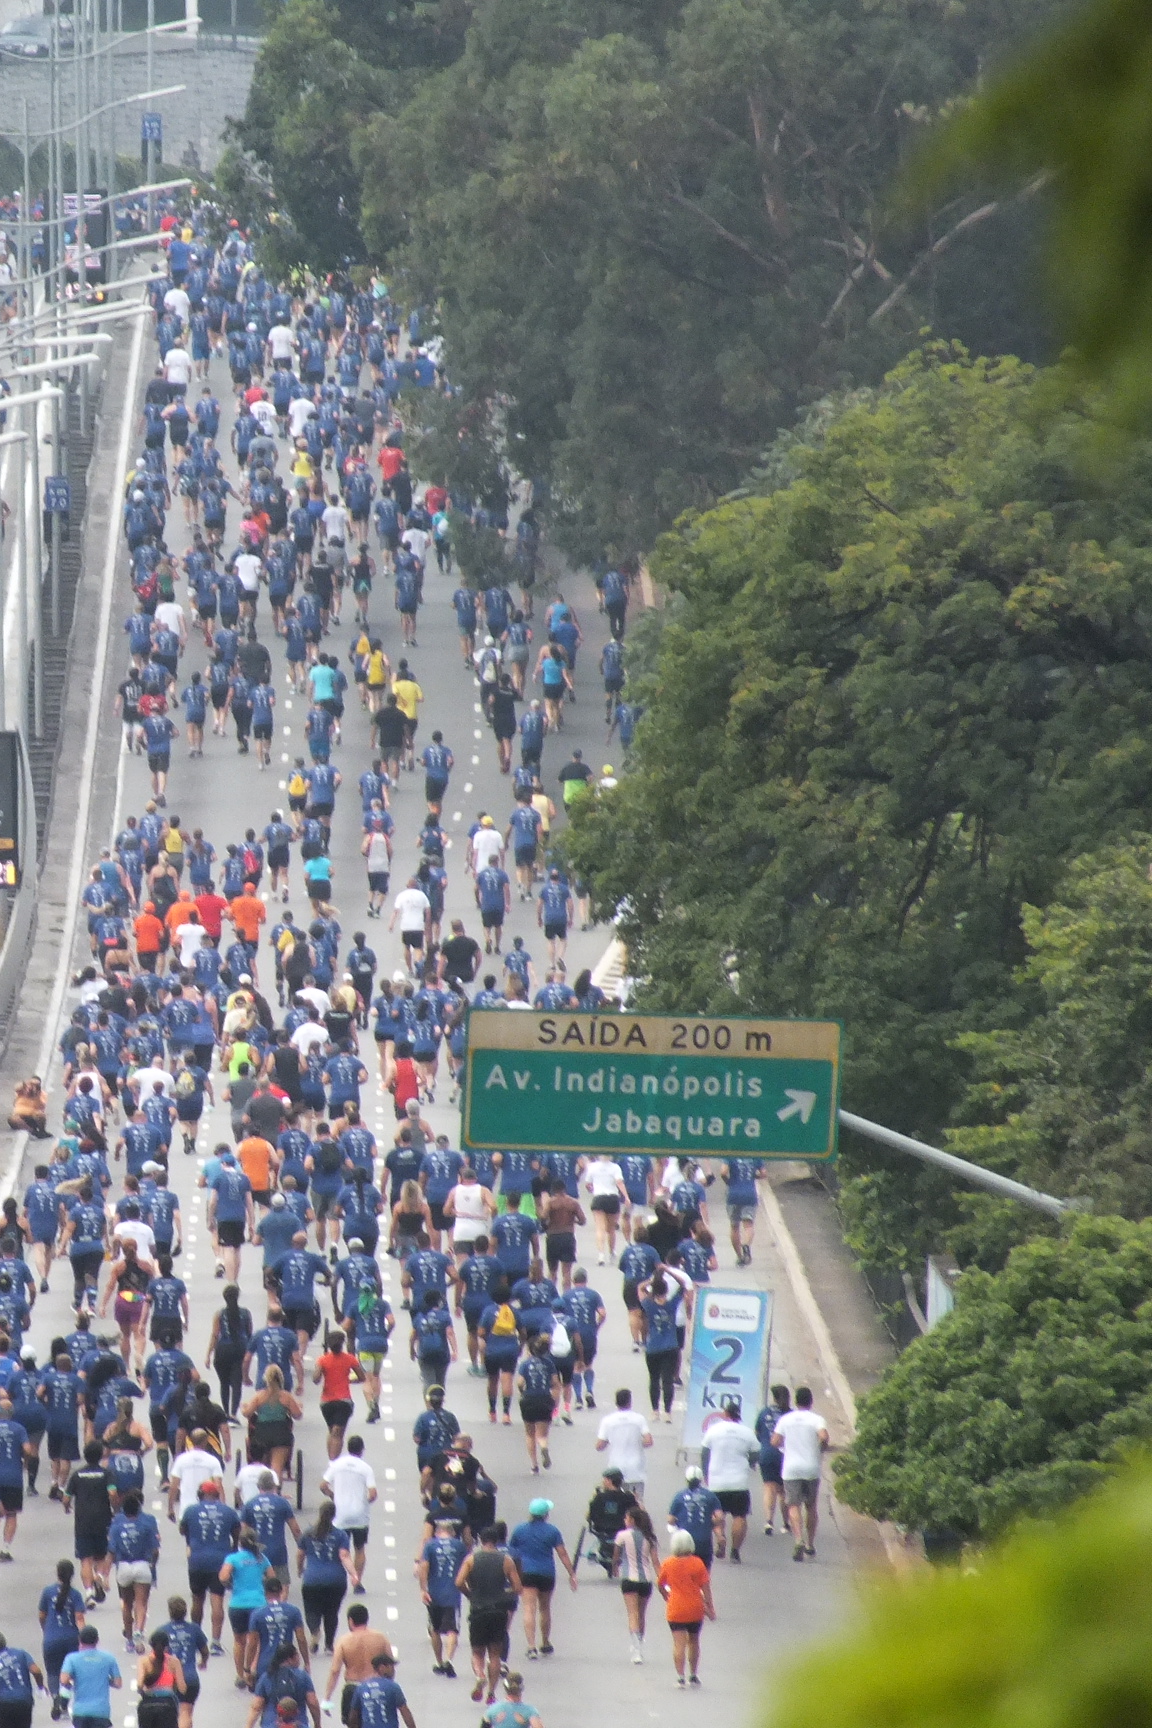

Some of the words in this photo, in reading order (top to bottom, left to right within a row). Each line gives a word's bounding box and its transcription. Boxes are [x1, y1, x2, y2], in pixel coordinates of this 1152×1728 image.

[538, 1016, 647, 1048] SAÍDA
[670, 1023, 732, 1050] 200
[745, 1029, 772, 1052] m
[485, 1064, 540, 1091] Av.
[554, 1065, 762, 1099] Indianópolis
[582, 1107, 761, 1140] Jabaquara
[711, 1336, 745, 1384] 2
[702, 1385, 743, 1410] km
